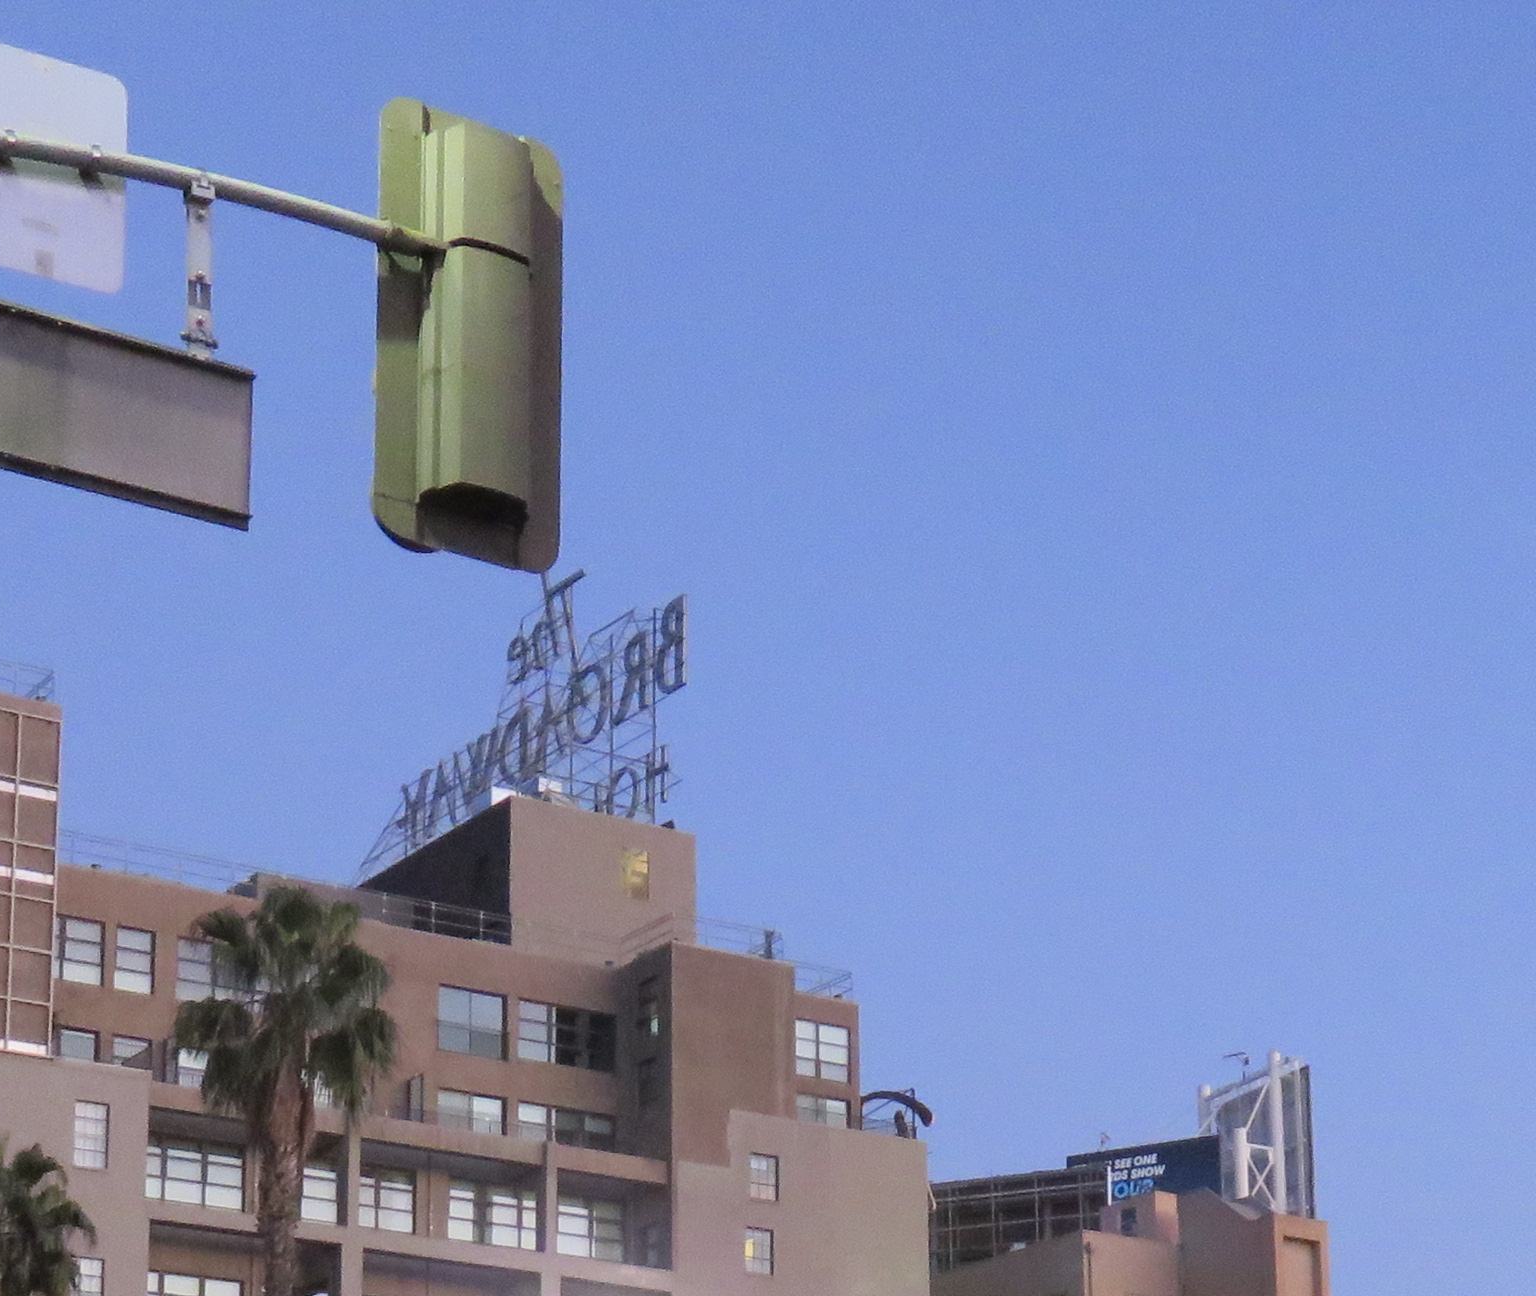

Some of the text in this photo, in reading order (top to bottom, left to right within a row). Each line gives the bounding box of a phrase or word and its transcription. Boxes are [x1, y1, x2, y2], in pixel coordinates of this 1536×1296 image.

[1115, 1153, 1158, 1169] SEE ONE
[1131, 1164, 1166, 1180] SHOW
